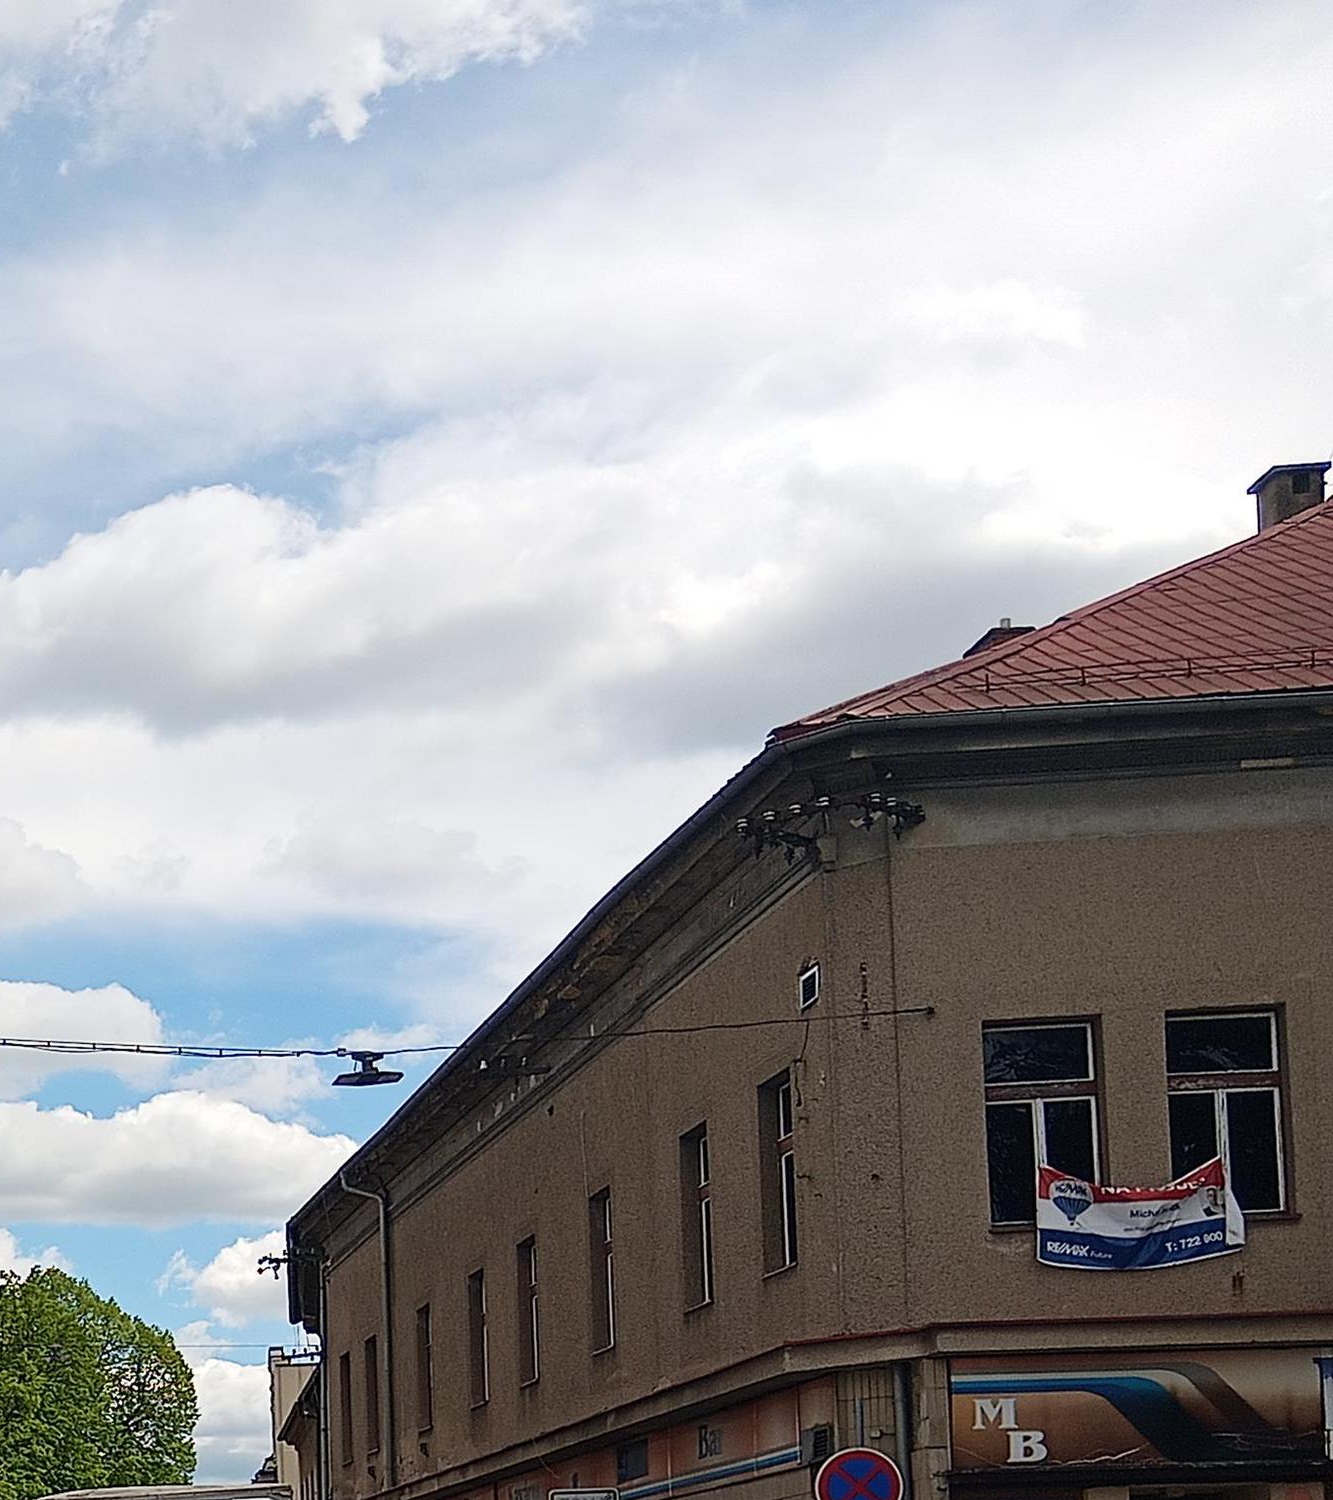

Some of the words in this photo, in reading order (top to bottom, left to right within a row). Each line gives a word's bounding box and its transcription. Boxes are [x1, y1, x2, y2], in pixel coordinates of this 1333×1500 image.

[1179, 1236, 1202, 1249] 722
[972, 1398, 1019, 1430] M
[1006, 1430, 1049, 1464] B
